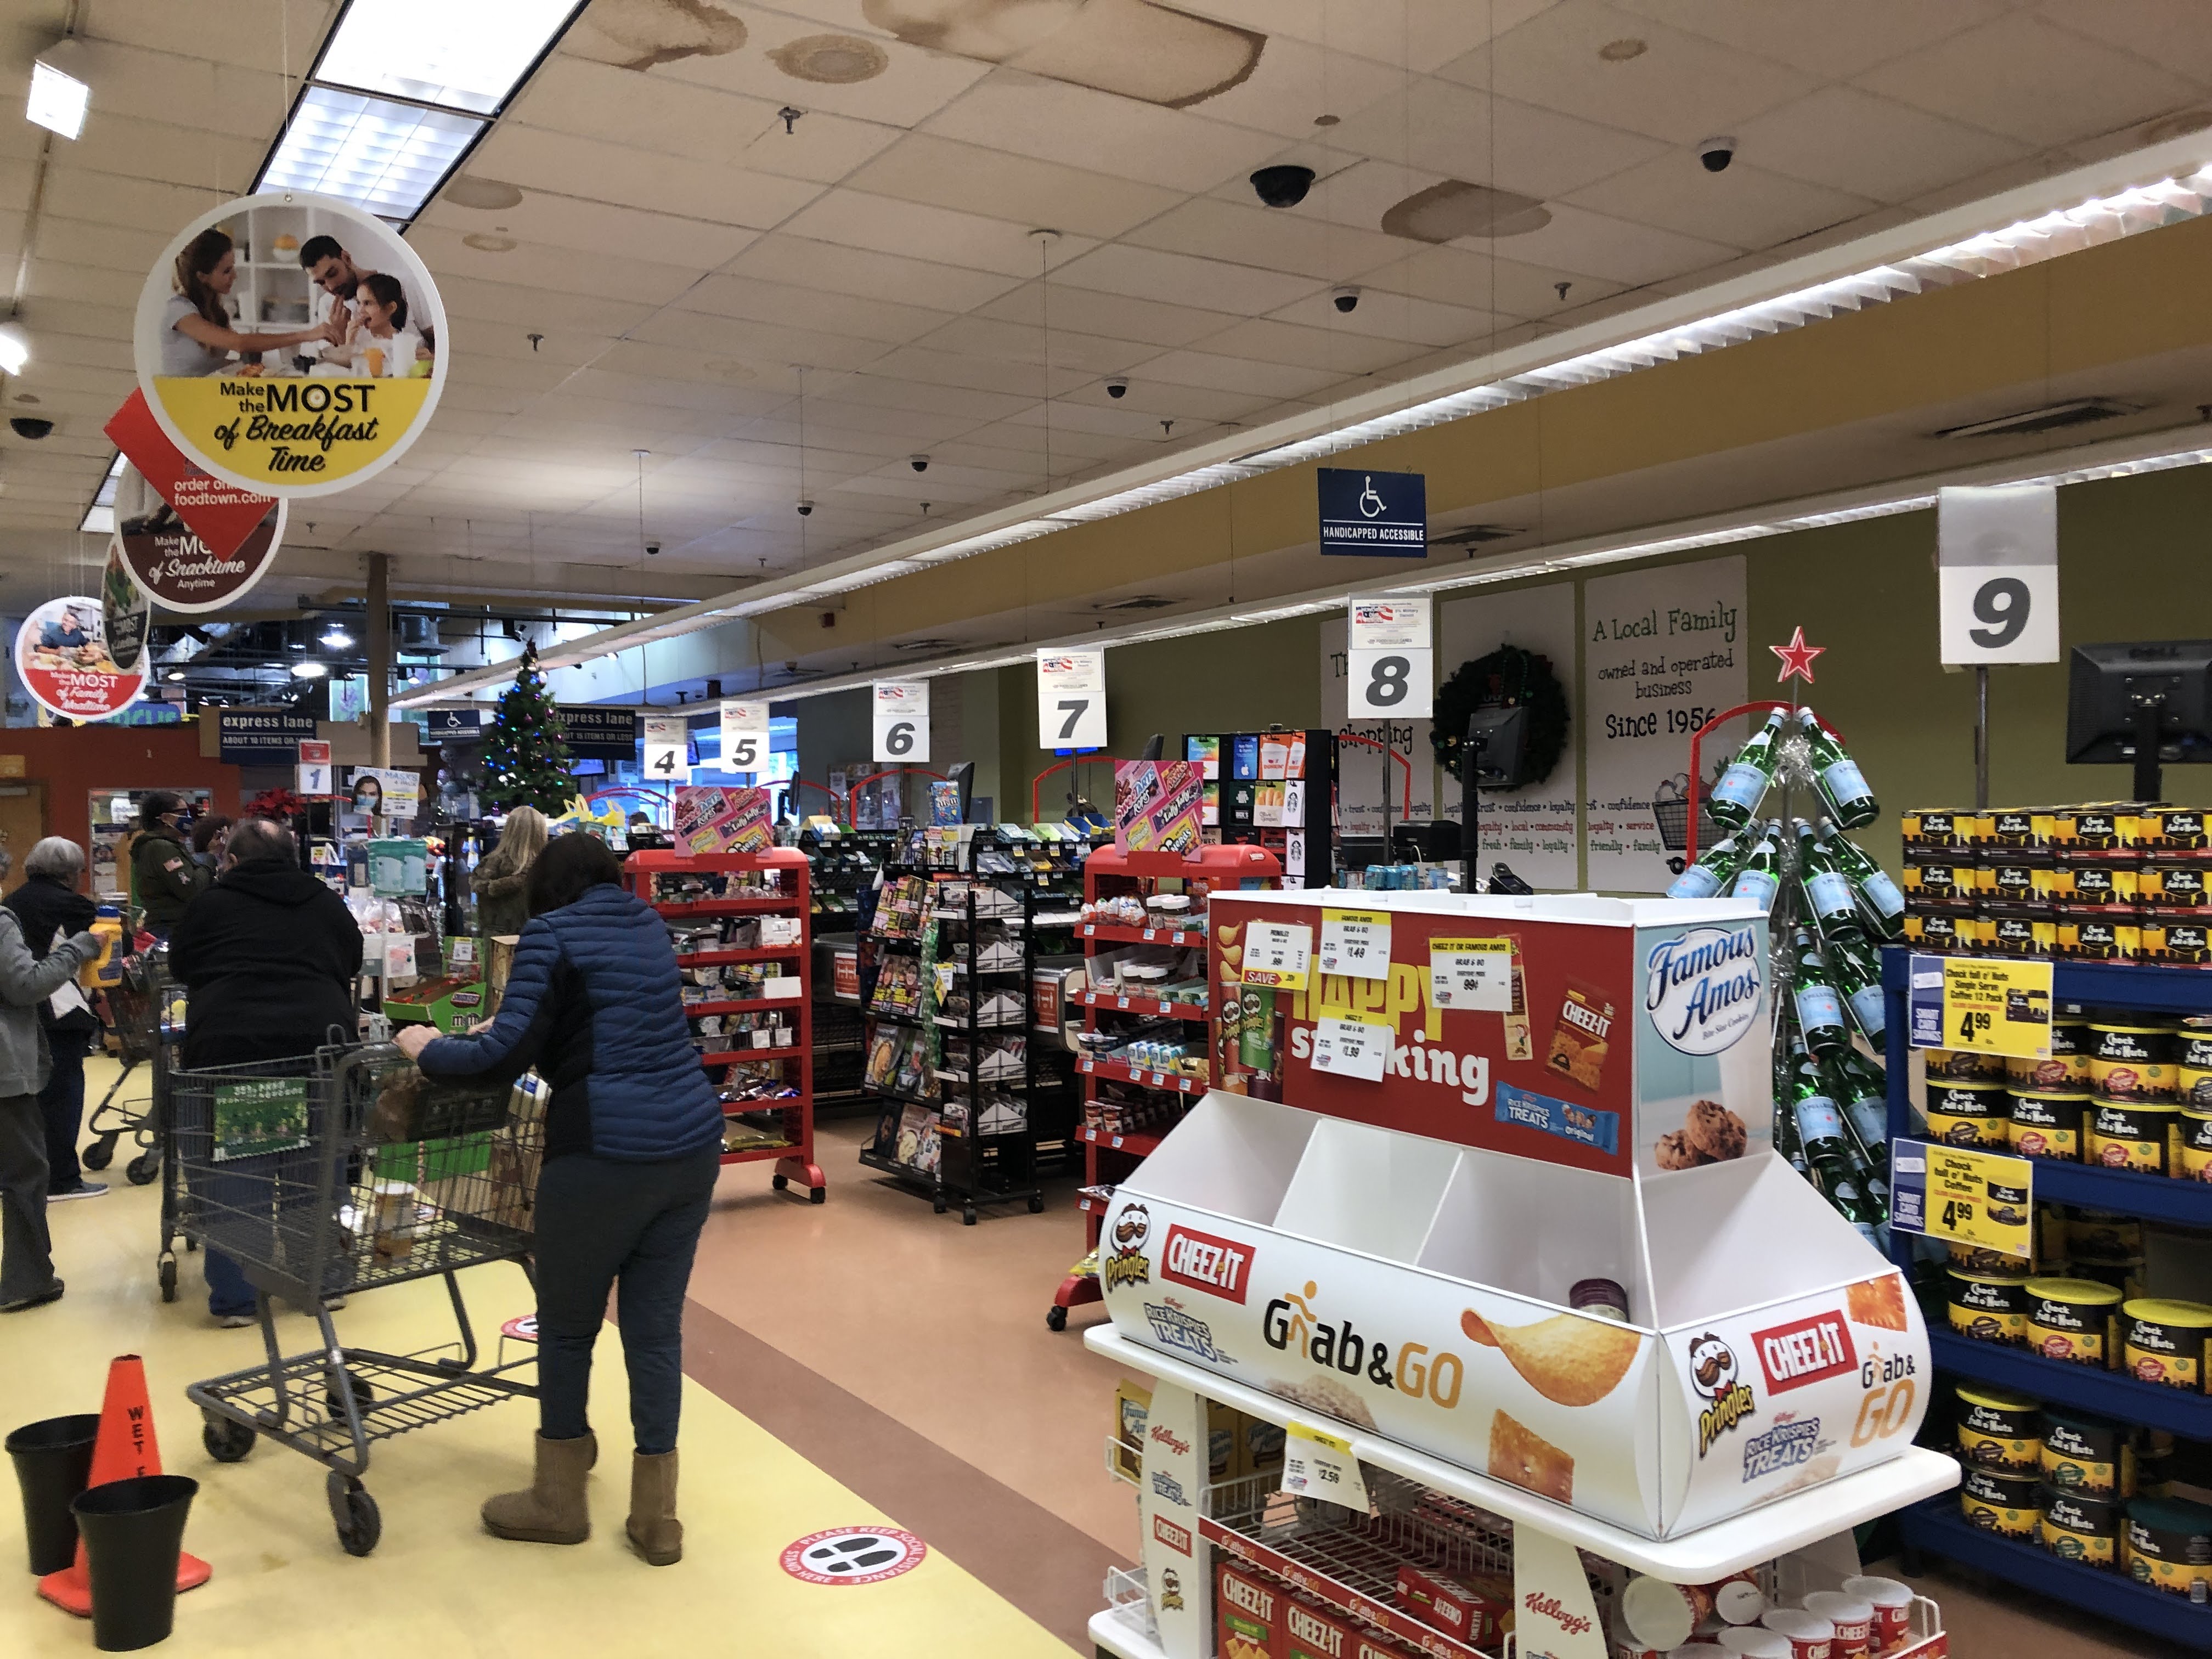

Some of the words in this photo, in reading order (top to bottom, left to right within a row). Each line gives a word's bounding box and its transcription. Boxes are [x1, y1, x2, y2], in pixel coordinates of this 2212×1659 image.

[220, 382, 265, 396] Make
[267, 383, 376, 412] MOST
[239, 398, 265, 412] the
[214, 416, 240, 451] of
[246, 414, 379, 452] Breakfast
[268, 446, 326, 472] Time
[174, 478, 210, 492] order
[174, 493, 271, 506] foodtown.com
[155, 536, 179, 546] Make
[1323, 527, 1377, 539] HANDICAPPED
[1380, 528, 1424, 541] ACCESSIBLE
[149, 561, 164, 585] of
[166, 556, 245, 577] Snacktime
[177, 579, 215, 591] Anytime
[1593, 620, 1607, 641] A
[1612, 609, 1658, 640] Local
[1668, 601, 1737, 642] Family
[1970, 577, 2031, 648] 9
[1598, 659, 1636, 680] owned
[1641, 656, 1666, 675] and
[1671, 648, 1734, 676] operated
[71, 674, 118, 688] MOST
[1366, 656, 1410, 707] 8
[1635, 680, 1692, 699] business
[223, 716, 279, 730] express
[284, 715, 313, 729] lane
[606, 712, 633, 725] lane
[1057, 699, 1089, 738] 7
[1606, 712, 1657, 739] Since
[732, 739, 757, 766] 5
[885, 723, 916, 755] 6
[385, 771, 419, 781] MASKS
[654, 751, 675, 774] 4
[309, 769, 321, 789] 1
[1504, 799, 1541, 812] confidence
[1607, 797, 1650, 811] confidence
[1247, 971, 1277, 984] SAVE
[1647, 927, 1754, 1011] Famous
[1673, 969, 1760, 1040] Amos
[1562, 1000, 1611, 1038] CHEEZ-IT
[1291, 1023, 1489, 1106] sking
[1508, 1106, 1548, 1129] TREATS
[1105, 1251, 1150, 1294] Pringles
[1168, 1233, 1245, 1291] CHEEZ-IT
[1151, 1319, 1217, 1363] TREATS
[1764, 1322, 1847, 1381] CHEEZ-IT
[1699, 1383, 1756, 1459] Pringles
[1850, 1379, 1915, 1449] GO
[1743, 1436, 1815, 1482] TREATS
[799, 1527, 856, 1545] PLEASE
[898, 1533, 924, 1558] SOCIAL
[797, 1571, 834, 1583] HERE
[851, 1557, 920, 1583] DISTANCE
[1223, 1573, 1275, 1622] CHEEZ-IT
[1526, 1592, 1592, 1635] Kellogg's
[1288, 1606, 1344, 1659] CHEEZ-IT
